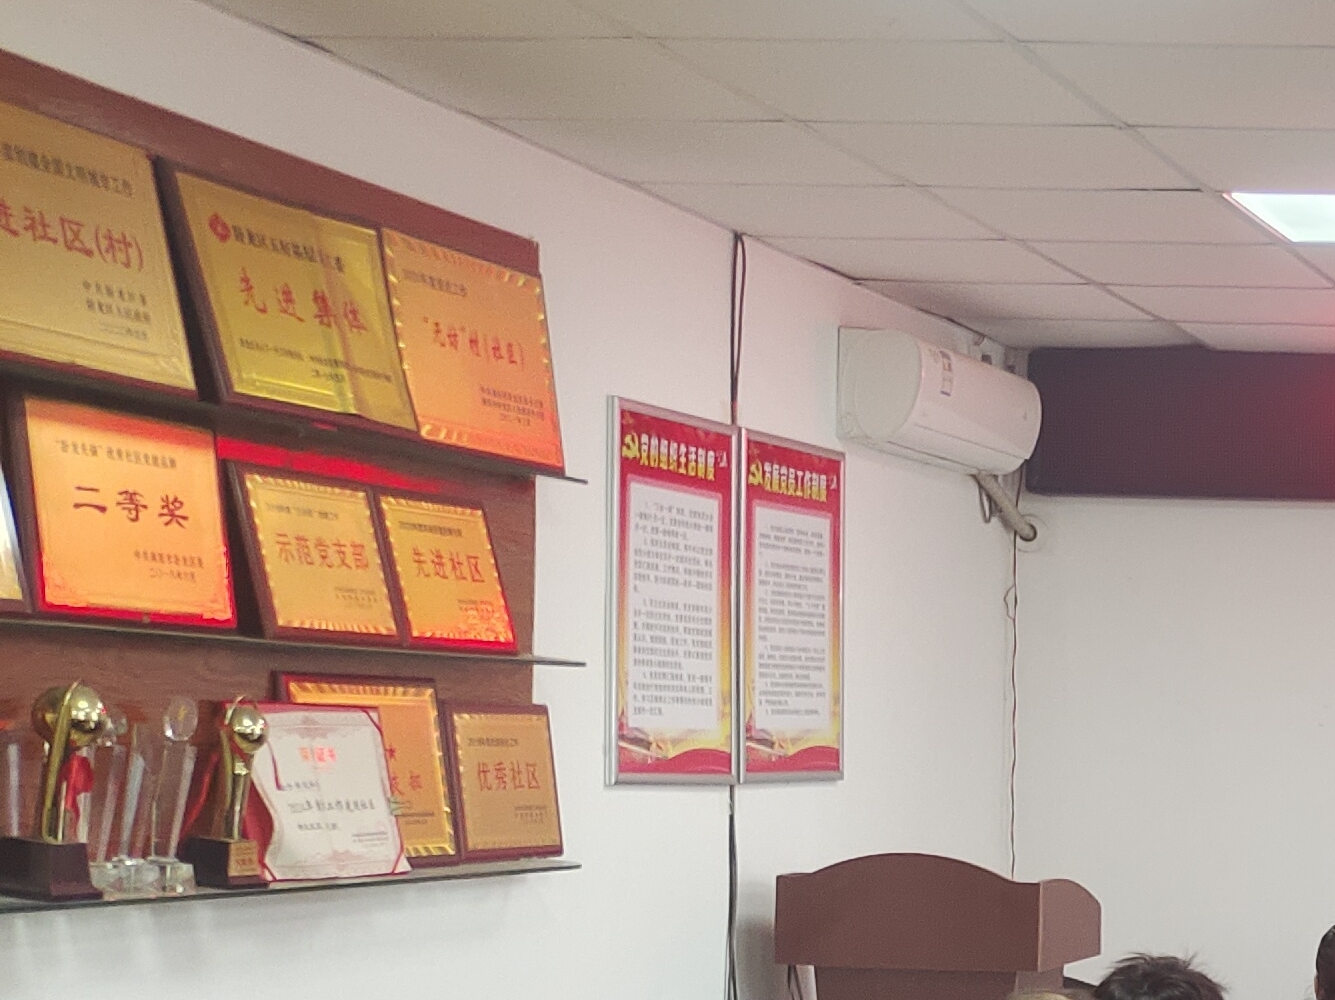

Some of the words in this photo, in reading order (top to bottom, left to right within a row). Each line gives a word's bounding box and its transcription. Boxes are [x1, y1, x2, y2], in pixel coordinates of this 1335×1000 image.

[73, 485, 189, 529] 二等奖
[275, 531, 369, 570] 示范党支部
[411, 546, 485, 583] 先进社区
[477, 761, 541, 792] 优秀社区
